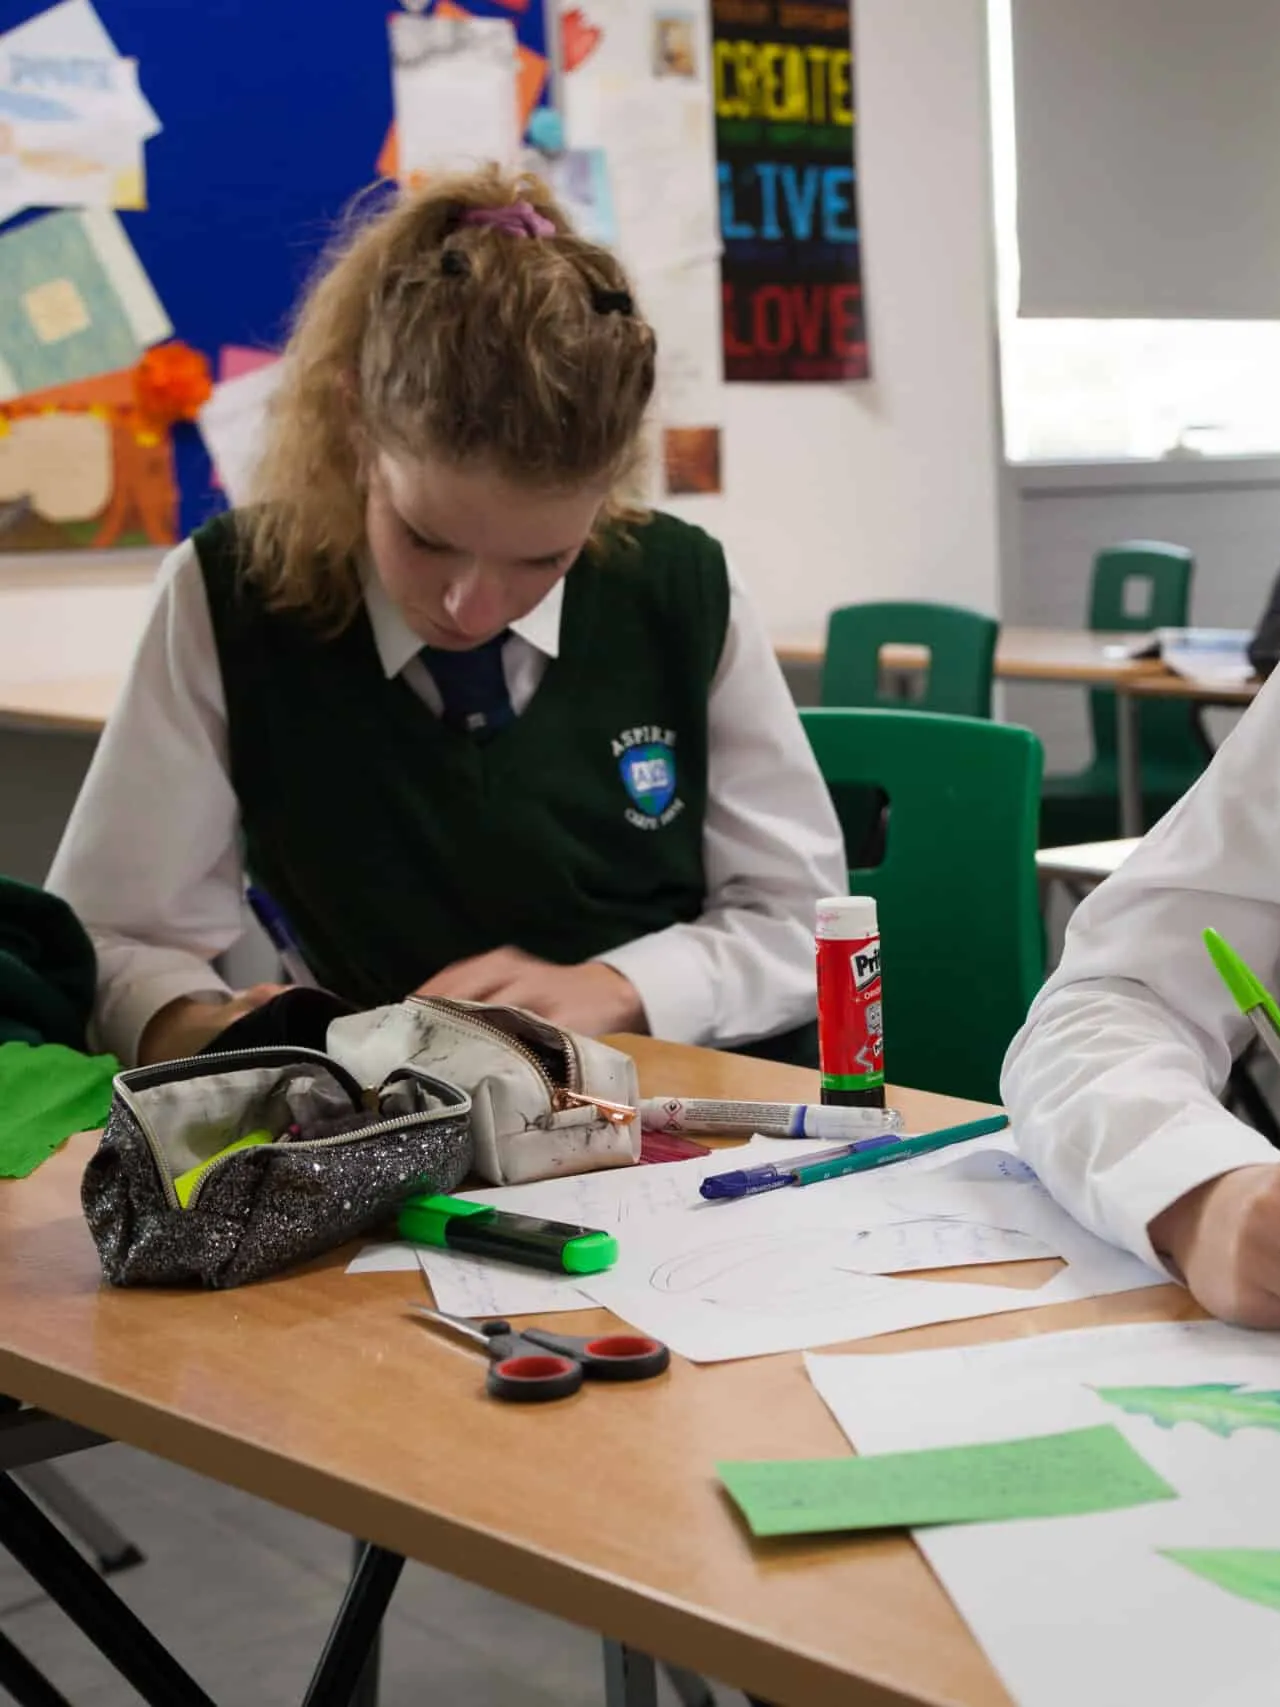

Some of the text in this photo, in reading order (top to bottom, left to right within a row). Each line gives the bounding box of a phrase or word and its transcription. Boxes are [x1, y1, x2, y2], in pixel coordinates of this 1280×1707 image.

[713, 38, 854, 126] CREATE
[715, 160, 860, 244] LIVE
[721, 283, 869, 358] LOVE
